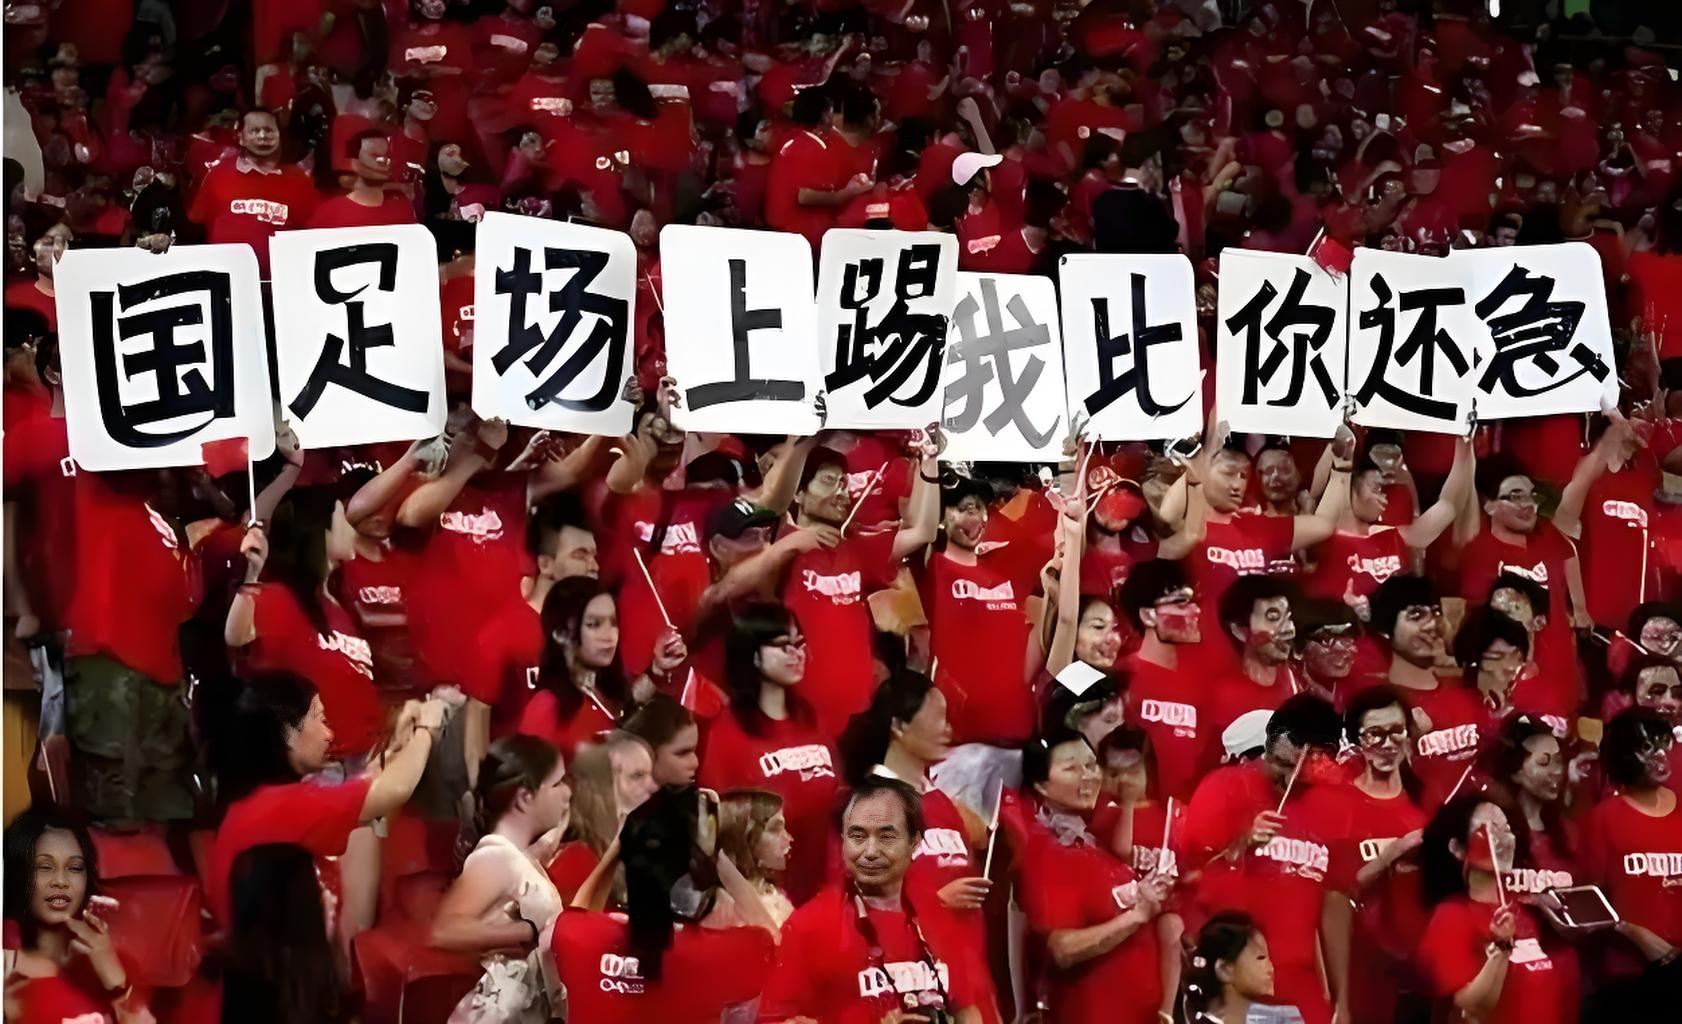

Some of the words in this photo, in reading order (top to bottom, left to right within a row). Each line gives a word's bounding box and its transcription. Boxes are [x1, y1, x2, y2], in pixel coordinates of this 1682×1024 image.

[89, 242, 1611, 449] 国足场上踢我比你还急
